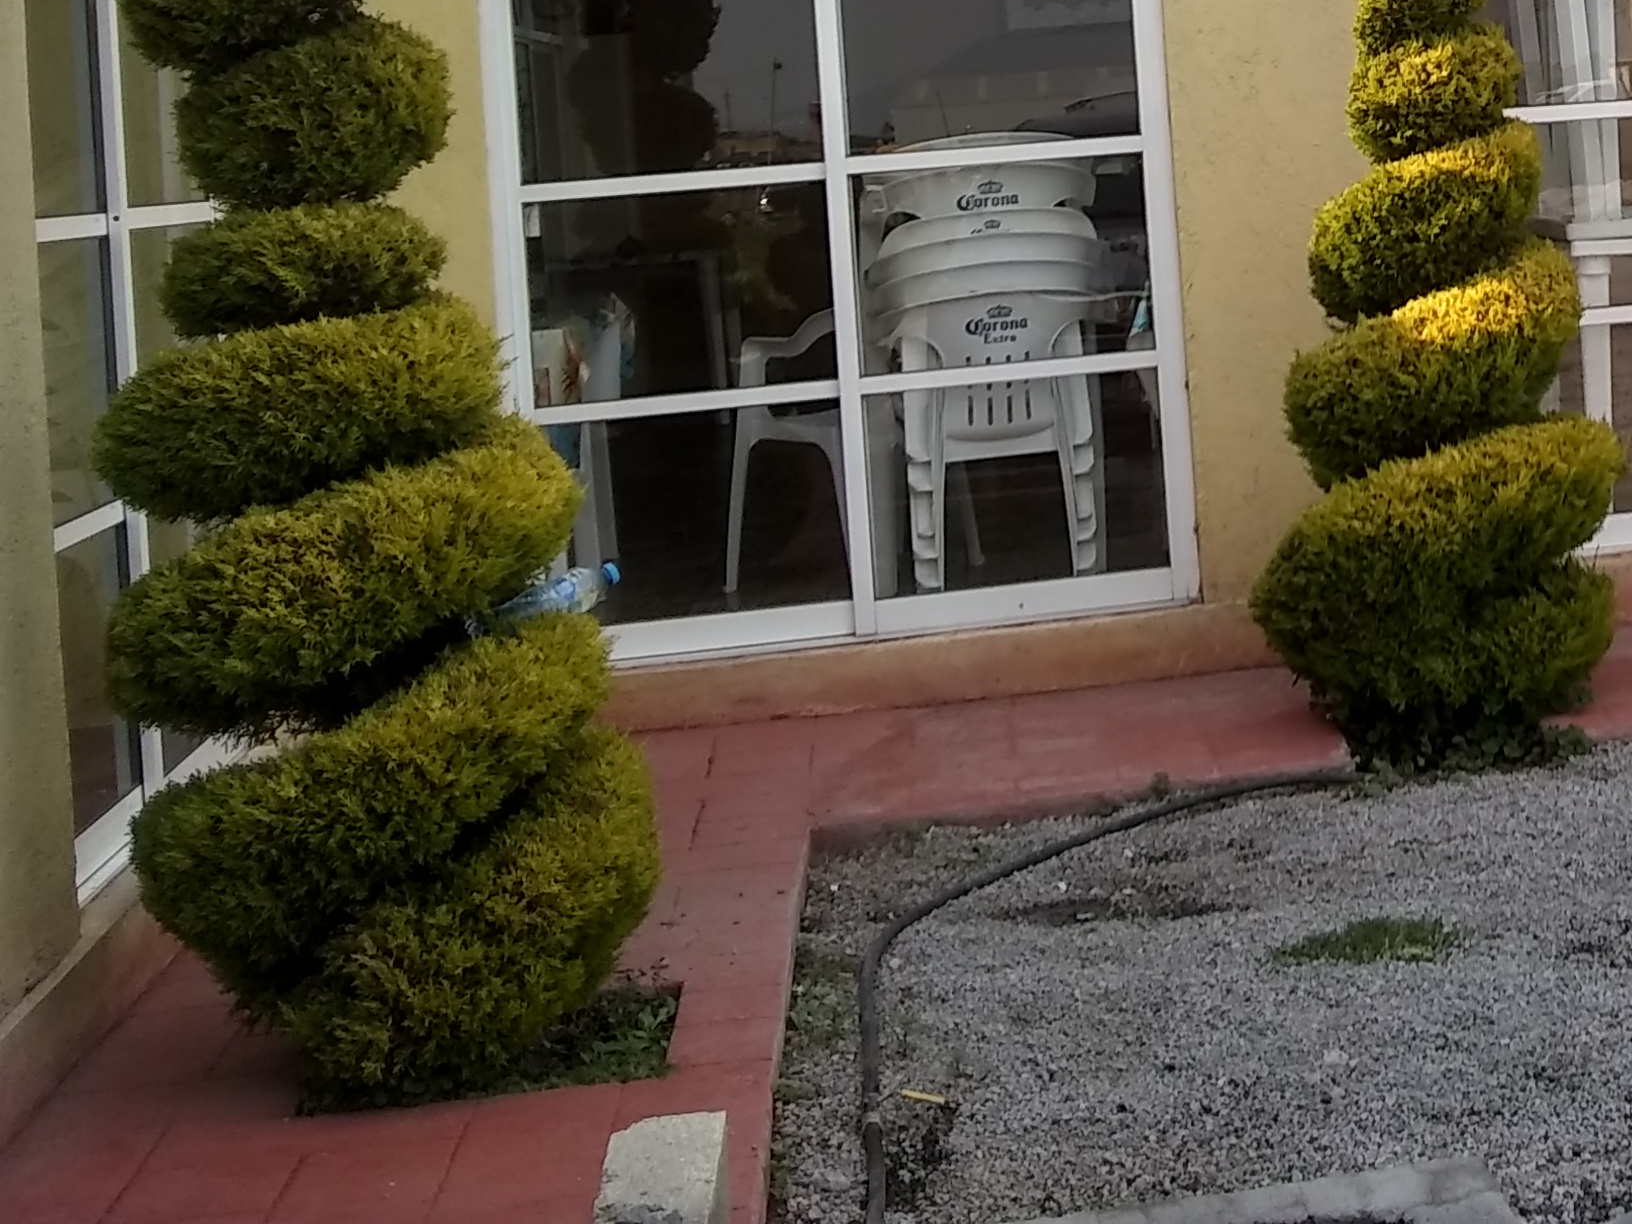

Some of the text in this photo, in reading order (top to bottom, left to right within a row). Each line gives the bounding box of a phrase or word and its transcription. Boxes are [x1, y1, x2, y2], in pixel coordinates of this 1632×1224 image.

[956, 192, 1019, 211] Corona
[965, 317, 1028, 336] Corona
[983, 334, 1017, 345] Extra
